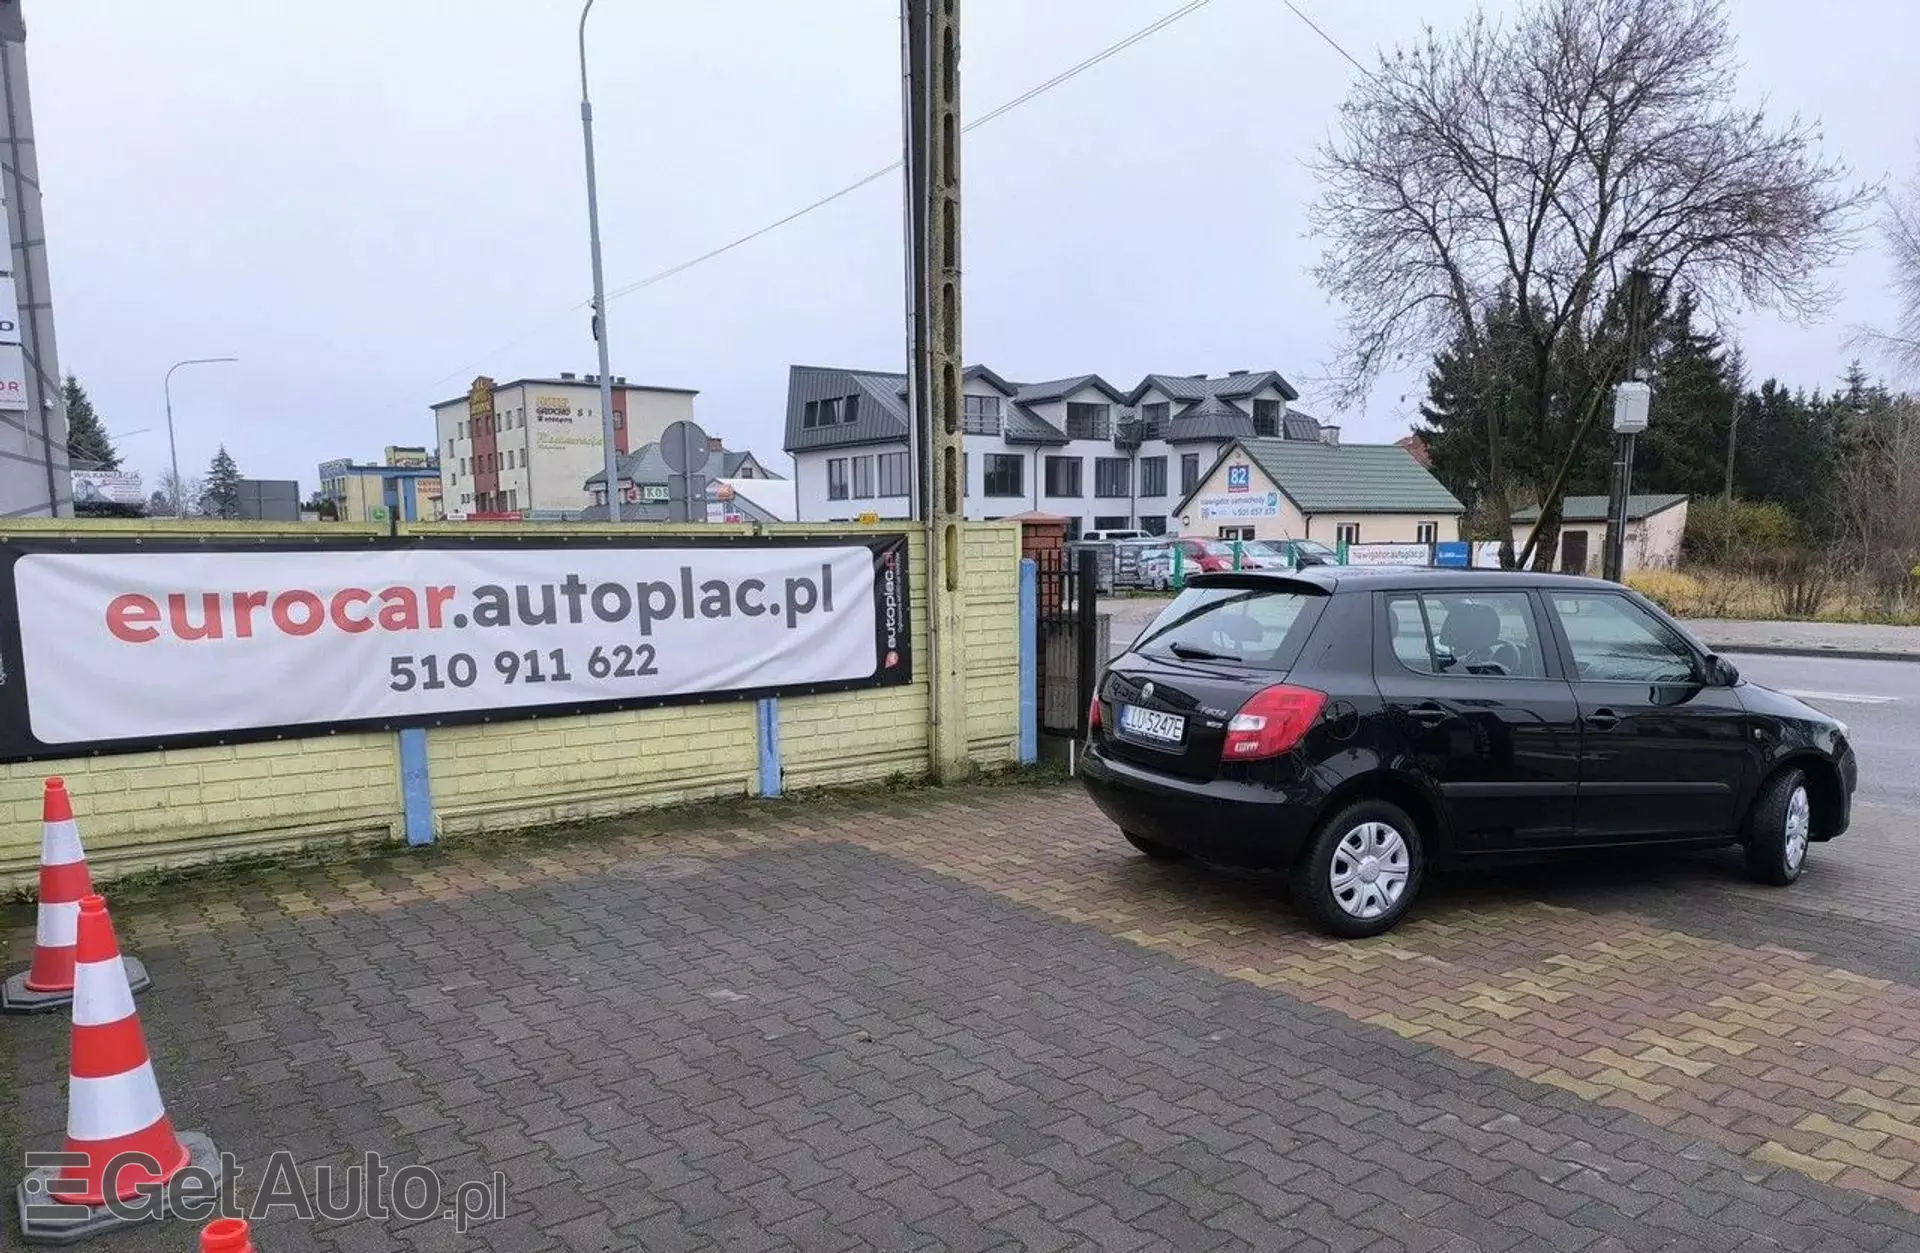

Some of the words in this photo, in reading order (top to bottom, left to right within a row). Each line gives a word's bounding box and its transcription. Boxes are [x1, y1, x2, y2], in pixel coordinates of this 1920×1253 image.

[1231, 468, 1247, 485] 82
[105, 563, 834, 643] eurocar.autoplac.pl
[884, 551, 897, 649] autoplac.pl
[389, 652, 477, 692] 510
[493, 647, 572, 685] 911
[587, 643, 659, 679] 622
[1146, 712, 1184, 739] 5247E
